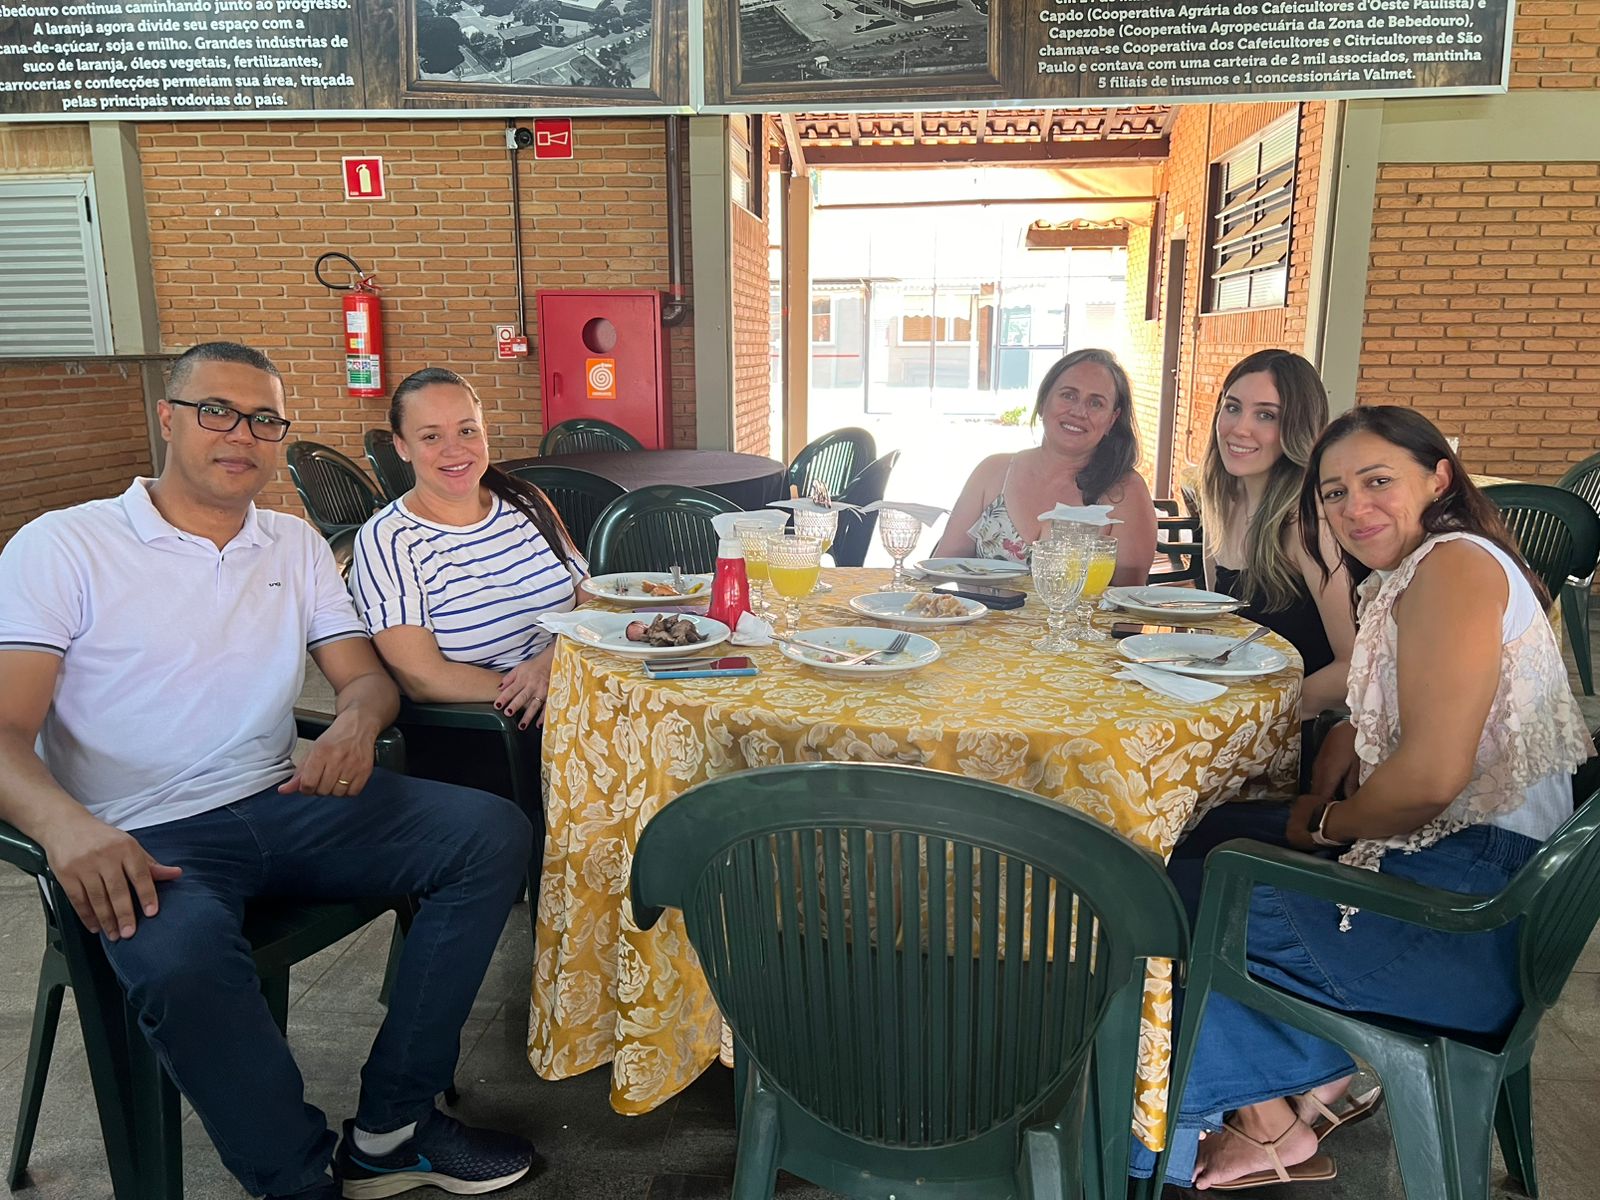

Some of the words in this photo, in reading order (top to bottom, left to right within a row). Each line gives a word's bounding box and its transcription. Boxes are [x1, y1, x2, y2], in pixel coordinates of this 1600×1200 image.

[0, 4, 59, 17] bedouro
[62, 2, 123, 16] continua
[125, 0, 212, 14] caminhando
[214, 0, 253, 15] junto
[256, 0, 274, 10] ao
[276, 0, 352, 13] progresso.
[1040, 9, 1084, 24] Capdo
[1088, 6, 1176, 22] (Cooperativa
[1178, 4, 1230, 19] Agrária
[1233, 3, 1258, 15] dos
[1262, 0, 1354, 14] Cafeicultores
[1357, 0, 1410, 11] d'Oeste
[1414, 0, 1474, 10] Paulista)
[1478, 0, 1486, 8] e
[34, 22, 44, 35] A
[45, 21, 94, 37] laranja
[96, 22, 136, 36] agora
[137, 18, 181, 32] divide
[183, 20, 208, 31] seu
[210, 20, 260, 33] espaço
[262, 19, 294, 30] com
[296, 19, 305, 29] a
[1049, 26, 1115, 41] Capezobe
[1119, 22, 1207, 38] (Cooperativa
[1210, 19, 1305, 35] Agropecuária
[1308, 18, 1326, 30] da
[1328, 17, 1364, 29] Zona
[1367, 16, 1385, 28] de
[1388, 13, 1474, 28] Bebedouro),
[106, 39, 134, 54] soja
[136, 41, 145, 51] e
[147, 37, 192, 50] milho.
[194, 36, 253, 49] Grandes
[255, 35, 328, 49] indústrias
[330, 34, 348, 48] de
[1039, 44, 1120, 56] chamava-se
[1123, 40, 1206, 55] Cooperativa
[1210, 39, 1234, 50] dos
[1238, 36, 1330, 49] Cafeicultores
[1333, 37, 1342, 47] e
[1344, 33, 1433, 46] Citricultores
[1436, 32, 1454, 44] de
[1457, 31, 1483, 44] São
[23, 62, 55, 72] suco
[57, 59, 74, 71] de
[76, 57, 128, 73] laranja,
[130, 57, 167, 69] óleos
[169, 55, 231, 71] vegetais,
[234, 55, 322, 69] fertilizantes,
[1038, 61, 1076, 73] Paulo
[1079, 63, 1087, 72] e
[1090, 60, 1144, 71] contava
[1148, 60, 1177, 69] com
[1180, 59, 1210, 68] uma
[1214, 55, 1268, 67] carteira
[1271, 54, 1288, 66] de
[1291, 53, 1300, 65] 2
[1303, 52, 1326, 64] mil
[1329, 51, 1410, 64] associados,
[1413, 49, 1482, 61] mantinha
[0, 78, 72, 91] carrocerias
[74, 80, 82, 89] e
[84, 75, 160, 91] confecções
[162, 74, 233, 90] permeiam
[235, 77, 260, 87] sua
[263, 73, 298, 88] área,
[300, 73, 355, 89] traçada
[1098, 77, 1106, 88] 5
[1110, 76, 1148, 88] filiais
[1151, 75, 1168, 86] de
[1171, 75, 1229, 86] insumos
[1232, 75, 1240, 84] e
[1244, 72, 1252, 84] 1
[1255, 69, 1361, 84] concessionária
[1363, 68, 1416, 80] Valmet.
[62, 95, 98, 110] pelas
[100, 93, 168, 110] principais
[170, 93, 231, 106] rodovias
[233, 93, 252, 105] do
[254, 92, 288, 108] país.
